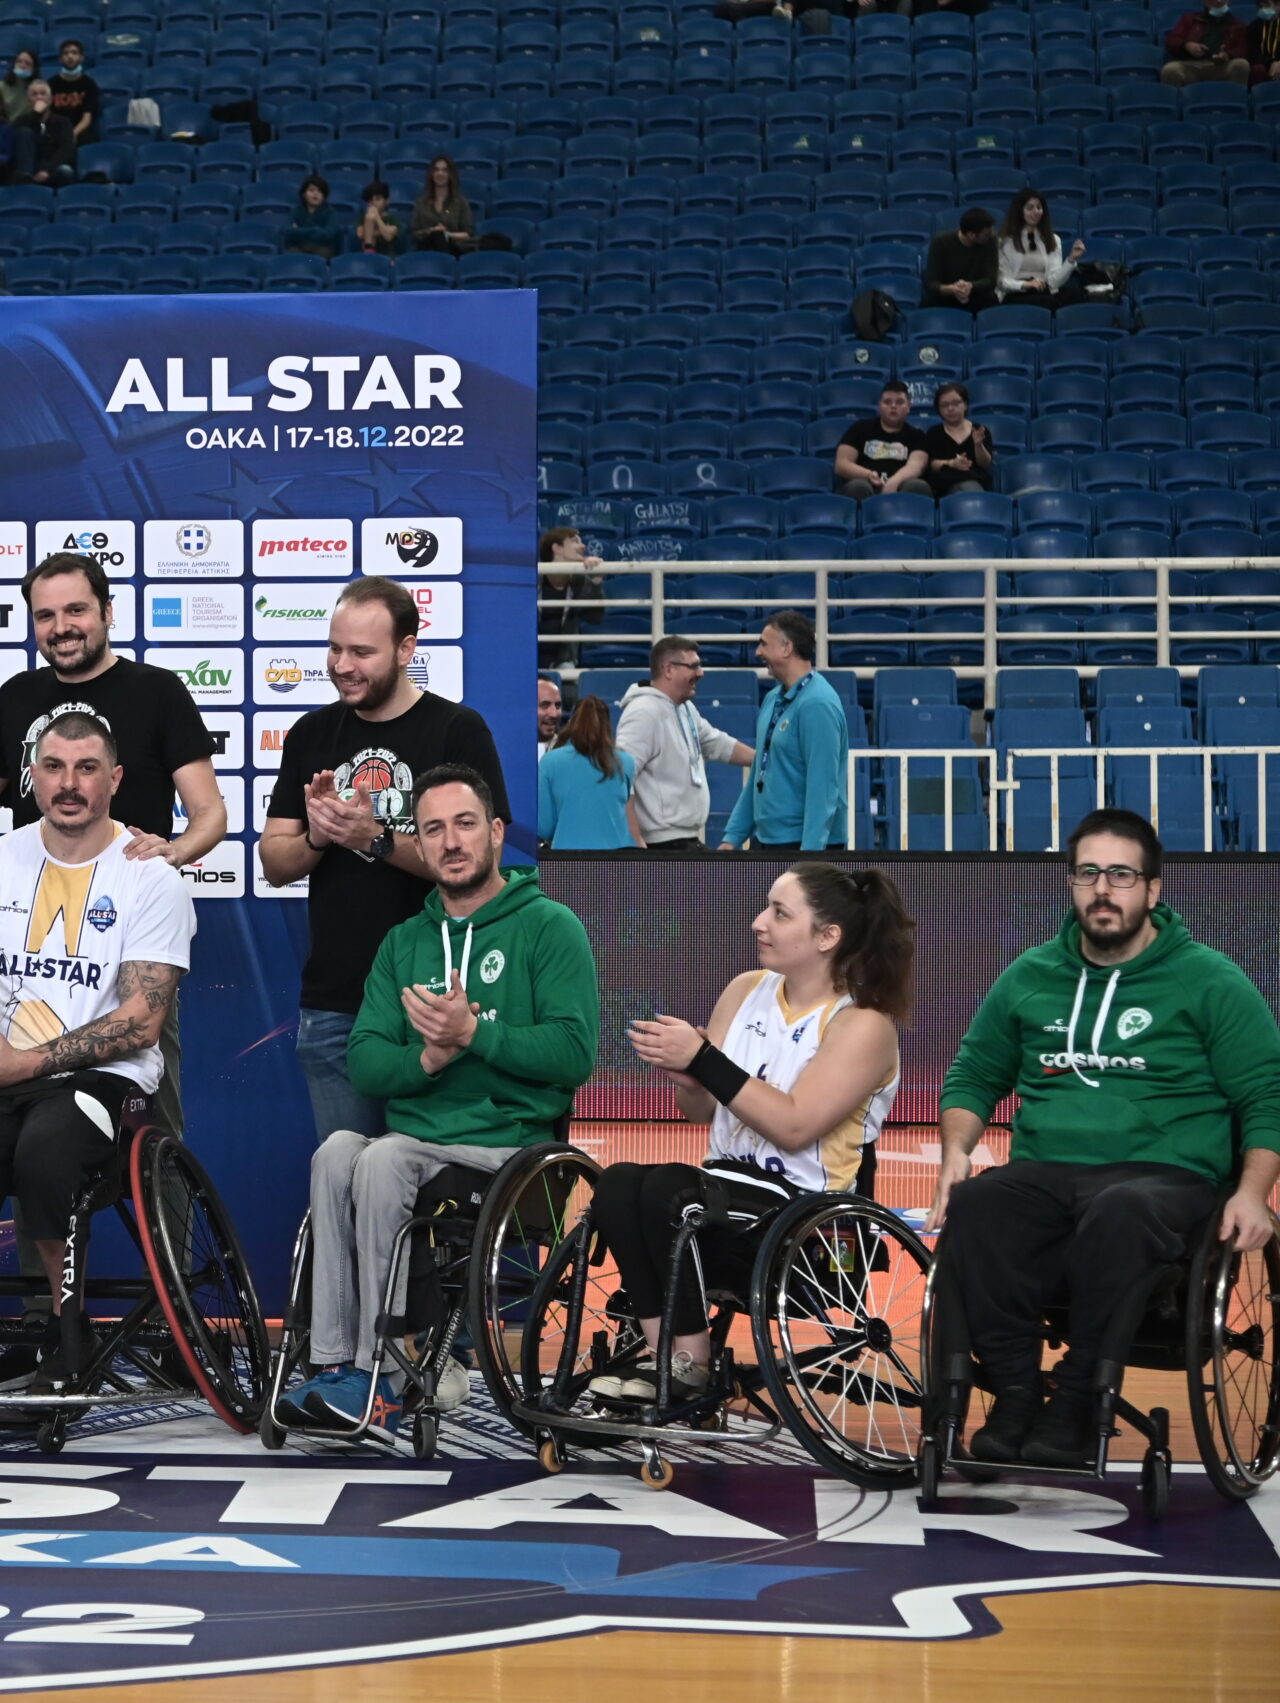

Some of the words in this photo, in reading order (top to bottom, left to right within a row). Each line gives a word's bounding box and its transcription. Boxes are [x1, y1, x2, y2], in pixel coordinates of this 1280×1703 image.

[105, 357, 253, 413] ALL
[267, 354, 464, 412] STAR
[185, 427, 266, 449] OAKA
[286, 425, 464, 448] 17-18.12.2022
[258, 537, 348, 557] mateco
[262, 608, 327, 618] FISIKON
[1039, 1052, 1147, 1071] COSMOS
